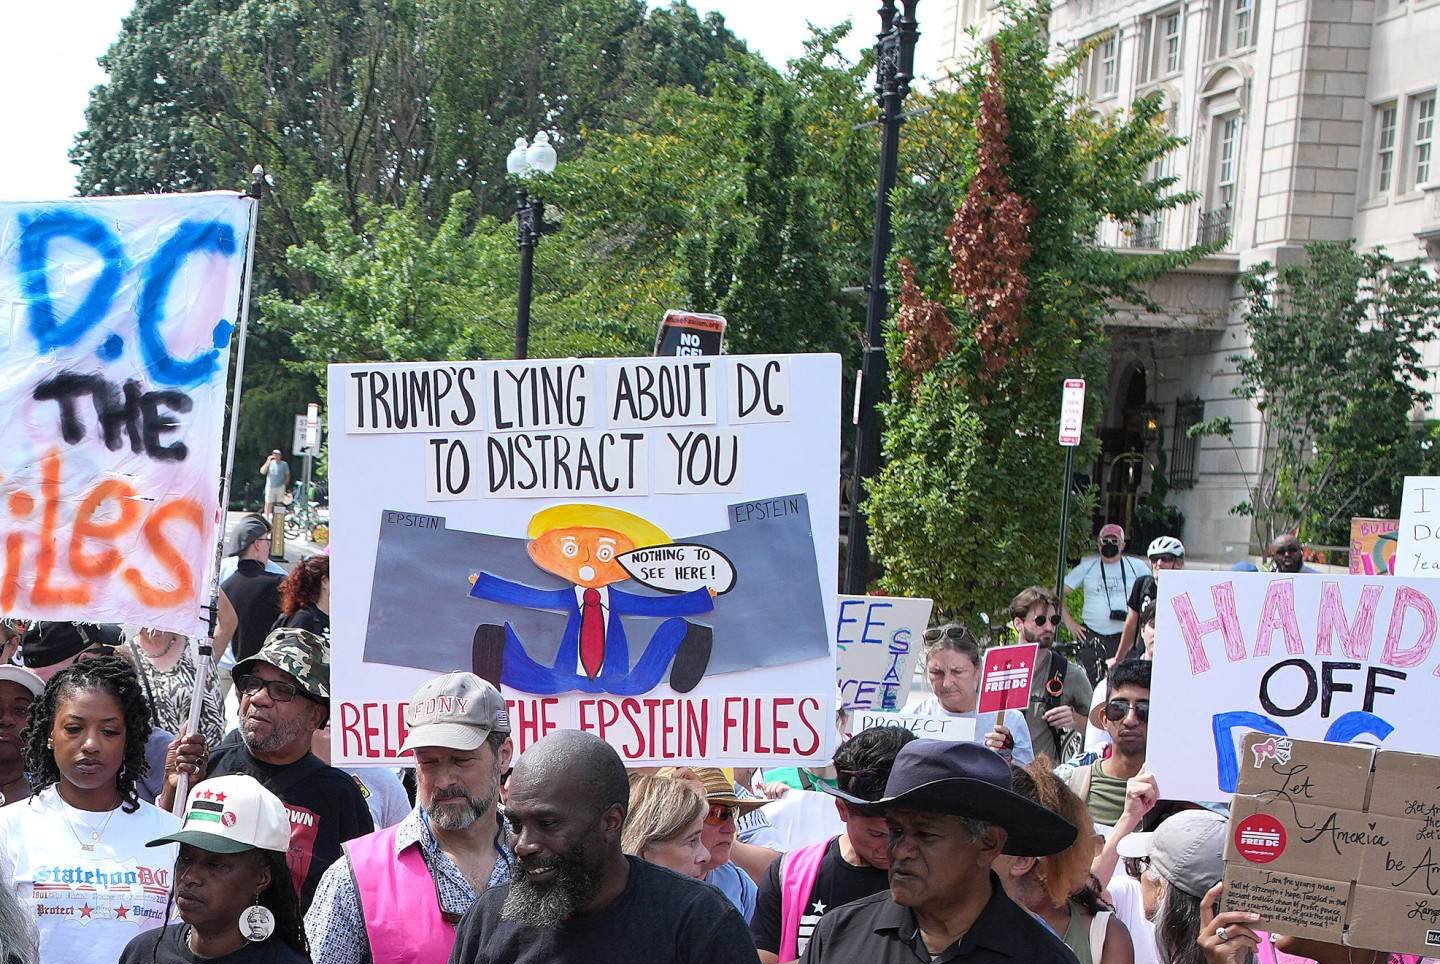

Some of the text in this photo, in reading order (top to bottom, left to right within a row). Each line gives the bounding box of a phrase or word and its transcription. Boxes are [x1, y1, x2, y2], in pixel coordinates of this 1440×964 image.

[680, 333, 700, 347] NO
[350, 360, 785, 430] TRUMP'S LYING ABOUT DC
[34, 371, 195, 462] THE
[430, 431, 739, 494] TO DISTRACT YOU
[387, 511, 440, 530] EPSTEIN
[734, 498, 800, 524] EPSTEIN
[631, 548, 711, 564] NOTHING TO
[641, 567, 665, 580] SEE
[837, 600, 893, 644] EE
[1171, 577, 1440, 677] HAND
[984, 677, 1028, 694] FREE DC
[1258, 658, 1407, 718] OFF
[414, 694, 470, 718] FDNY
[340, 702, 414, 758] RELE
[579, 696, 708, 758] EPSTEIN
[722, 696, 821, 757] FILES
[862, 714, 952, 733] PROTECT
[1266, 763, 1315, 806] Let
[1240, 838, 1280, 848] FREE DC
[1385, 851, 1406, 872] be
[36, 903, 75, 916] Protect
